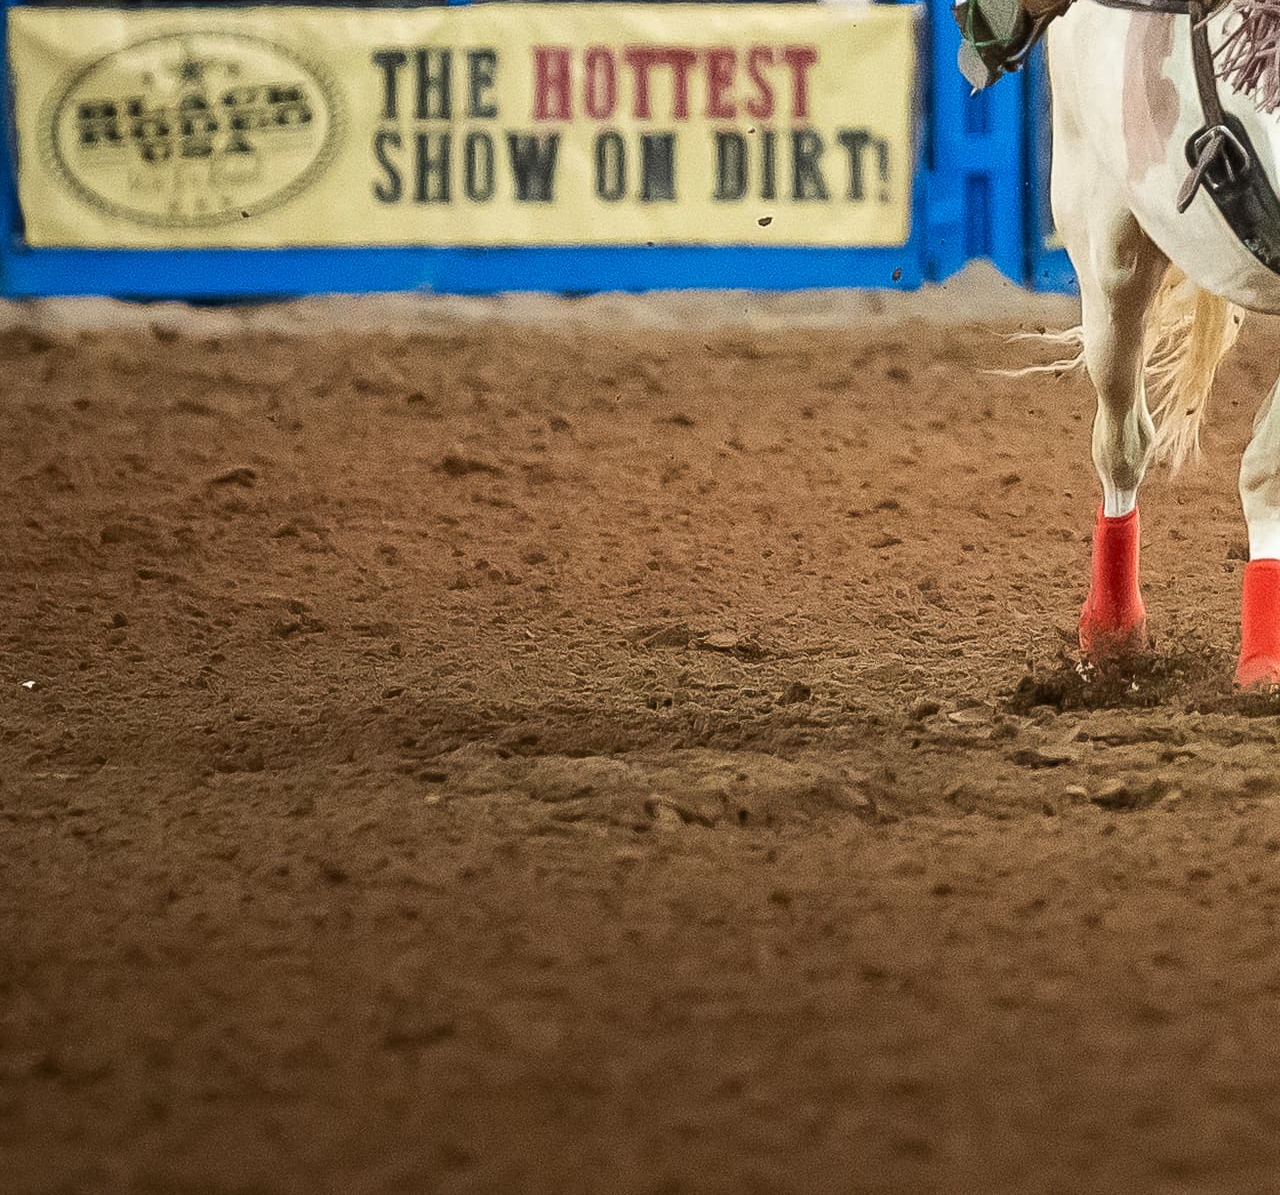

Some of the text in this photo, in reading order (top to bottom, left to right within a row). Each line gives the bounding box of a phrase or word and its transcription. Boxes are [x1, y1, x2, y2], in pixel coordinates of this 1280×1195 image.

[371, 44, 818, 121] THE HOTTEST
[372, 127, 890, 203] SHOW ON DIRT!
